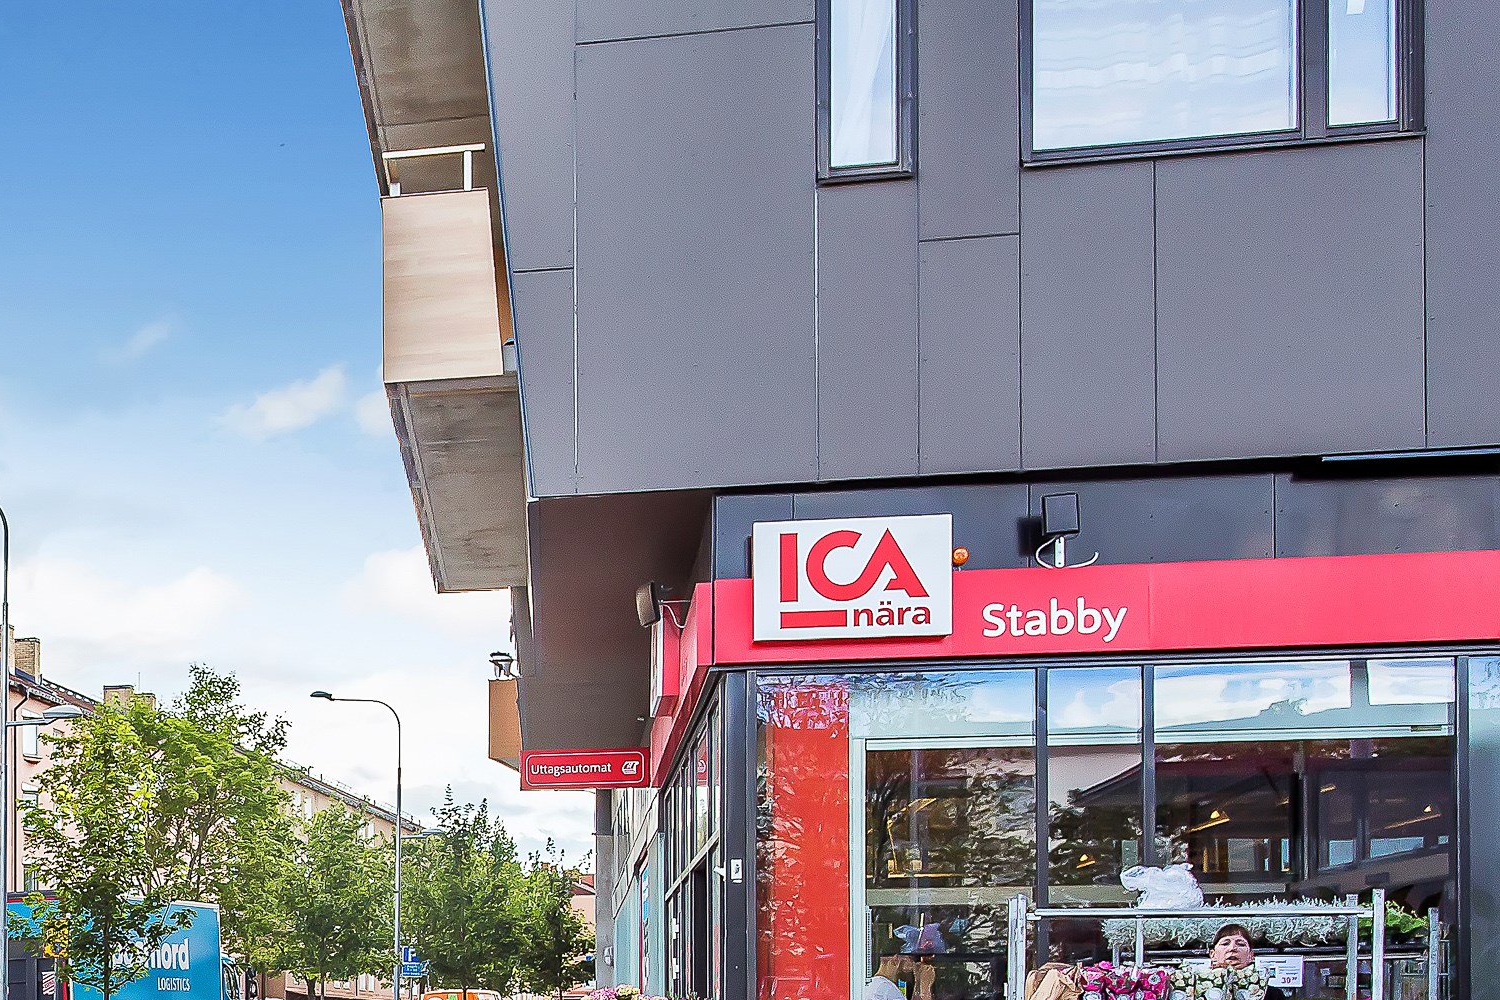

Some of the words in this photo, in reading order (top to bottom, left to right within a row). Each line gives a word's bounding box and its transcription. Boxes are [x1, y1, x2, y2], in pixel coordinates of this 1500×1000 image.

[780, 528, 930, 602] ICA
[853, 600, 931, 627] nära
[982, 596, 1128, 643] Stabby
[530, 762, 612, 777] Uttagsautomat
[109, 938, 190, 972] ponord
[157, 976, 191, 991] LOGISTICS
